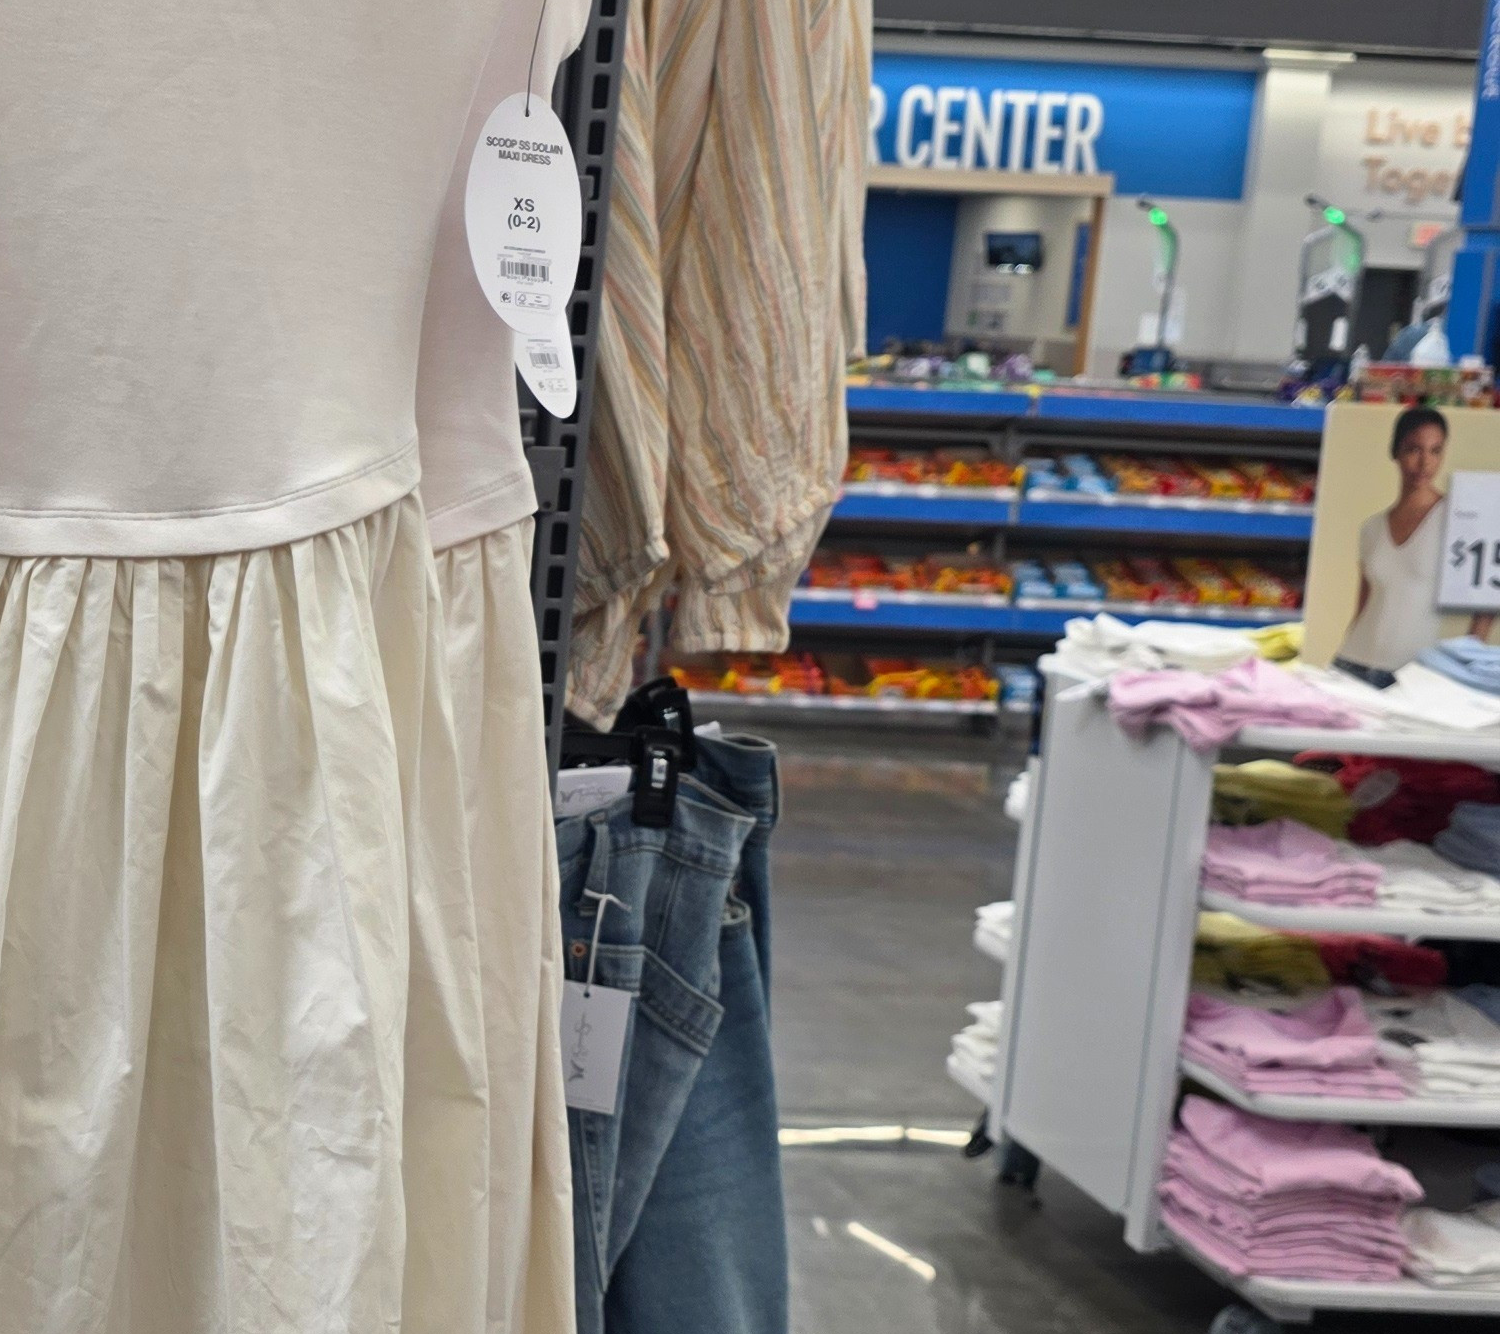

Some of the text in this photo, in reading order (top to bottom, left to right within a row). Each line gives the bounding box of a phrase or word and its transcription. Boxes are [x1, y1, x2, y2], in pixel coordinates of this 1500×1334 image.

[896, 83, 1105, 175] CENTER
[1363, 105, 1442, 148] Live
[486, 135, 517, 148] SCOOP
[518, 140, 531, 151] SS
[498, 150, 551, 165] MAXI DRESS
[513, 197, 535, 212] XS
[507, 213, 541, 233] (0-2)
